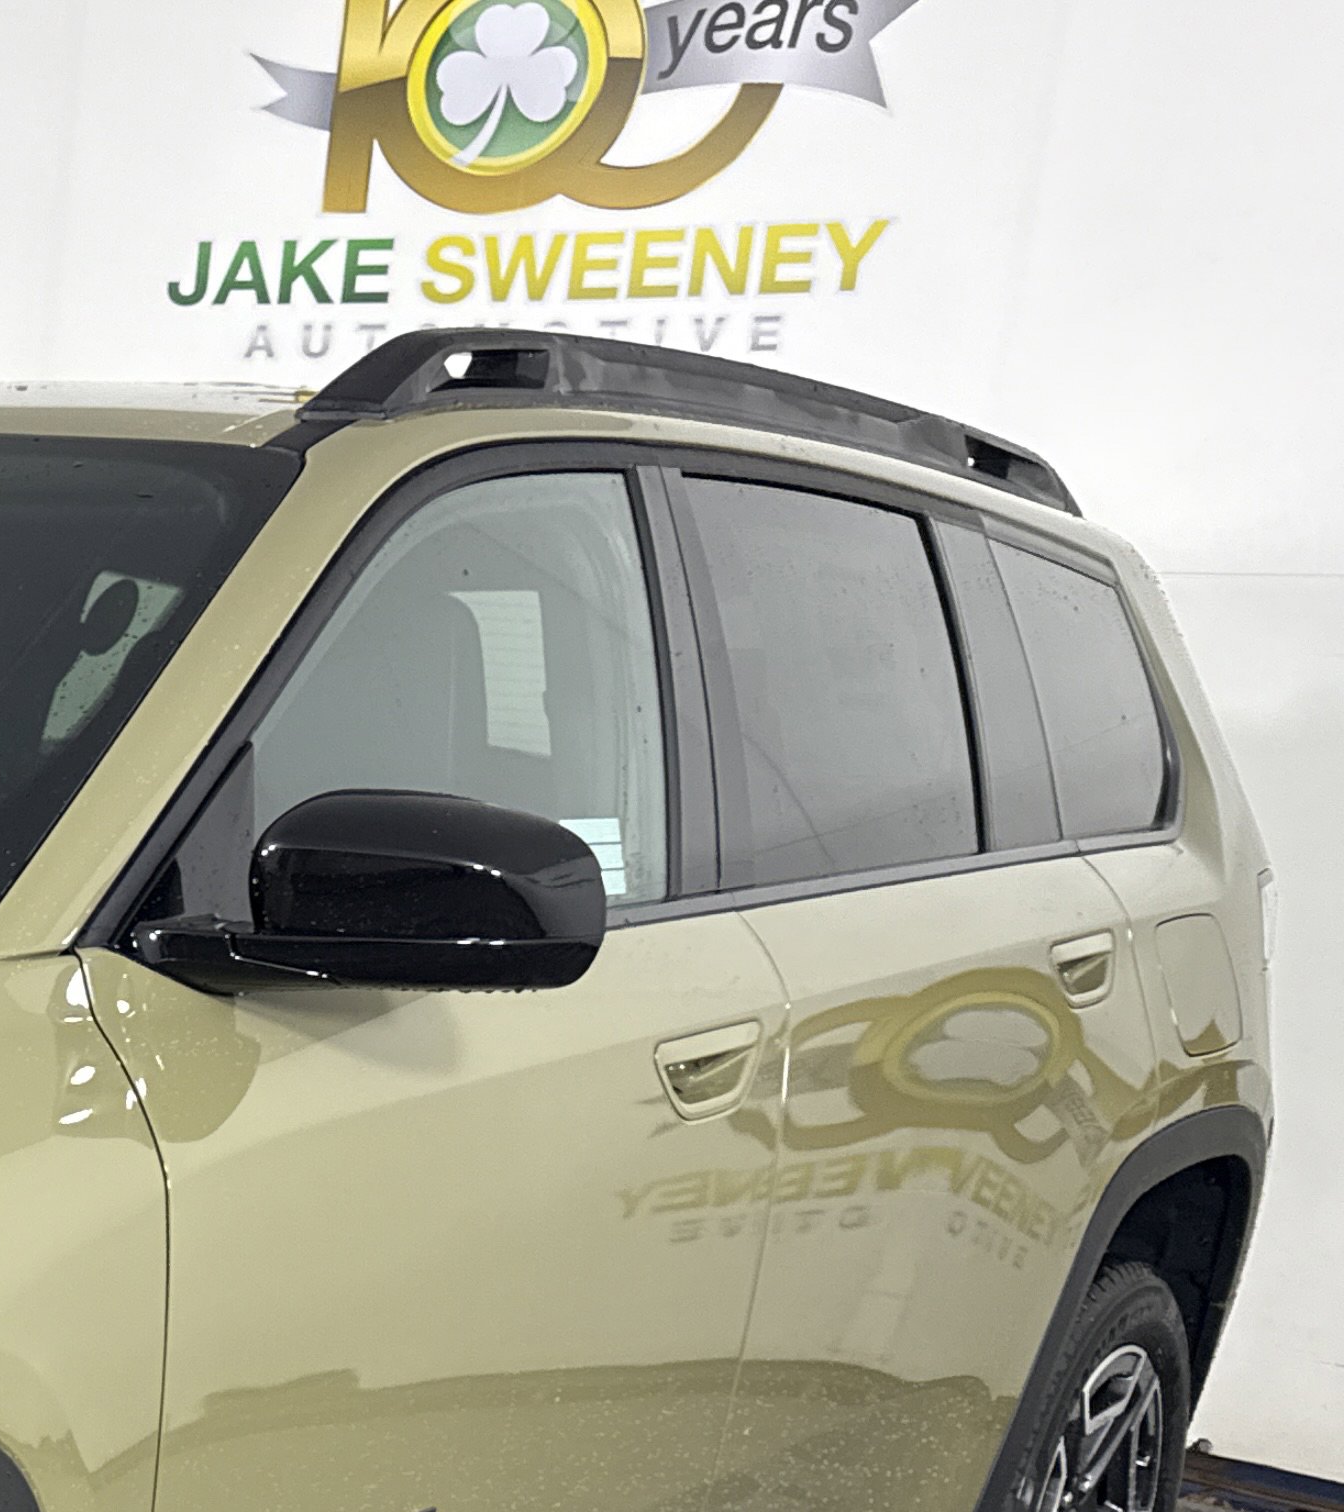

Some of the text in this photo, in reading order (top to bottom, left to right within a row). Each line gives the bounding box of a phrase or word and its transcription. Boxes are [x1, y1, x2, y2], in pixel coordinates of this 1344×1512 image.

[658, 0, 861, 80] years
[168, 219, 892, 307] JAKE SWEENEY
